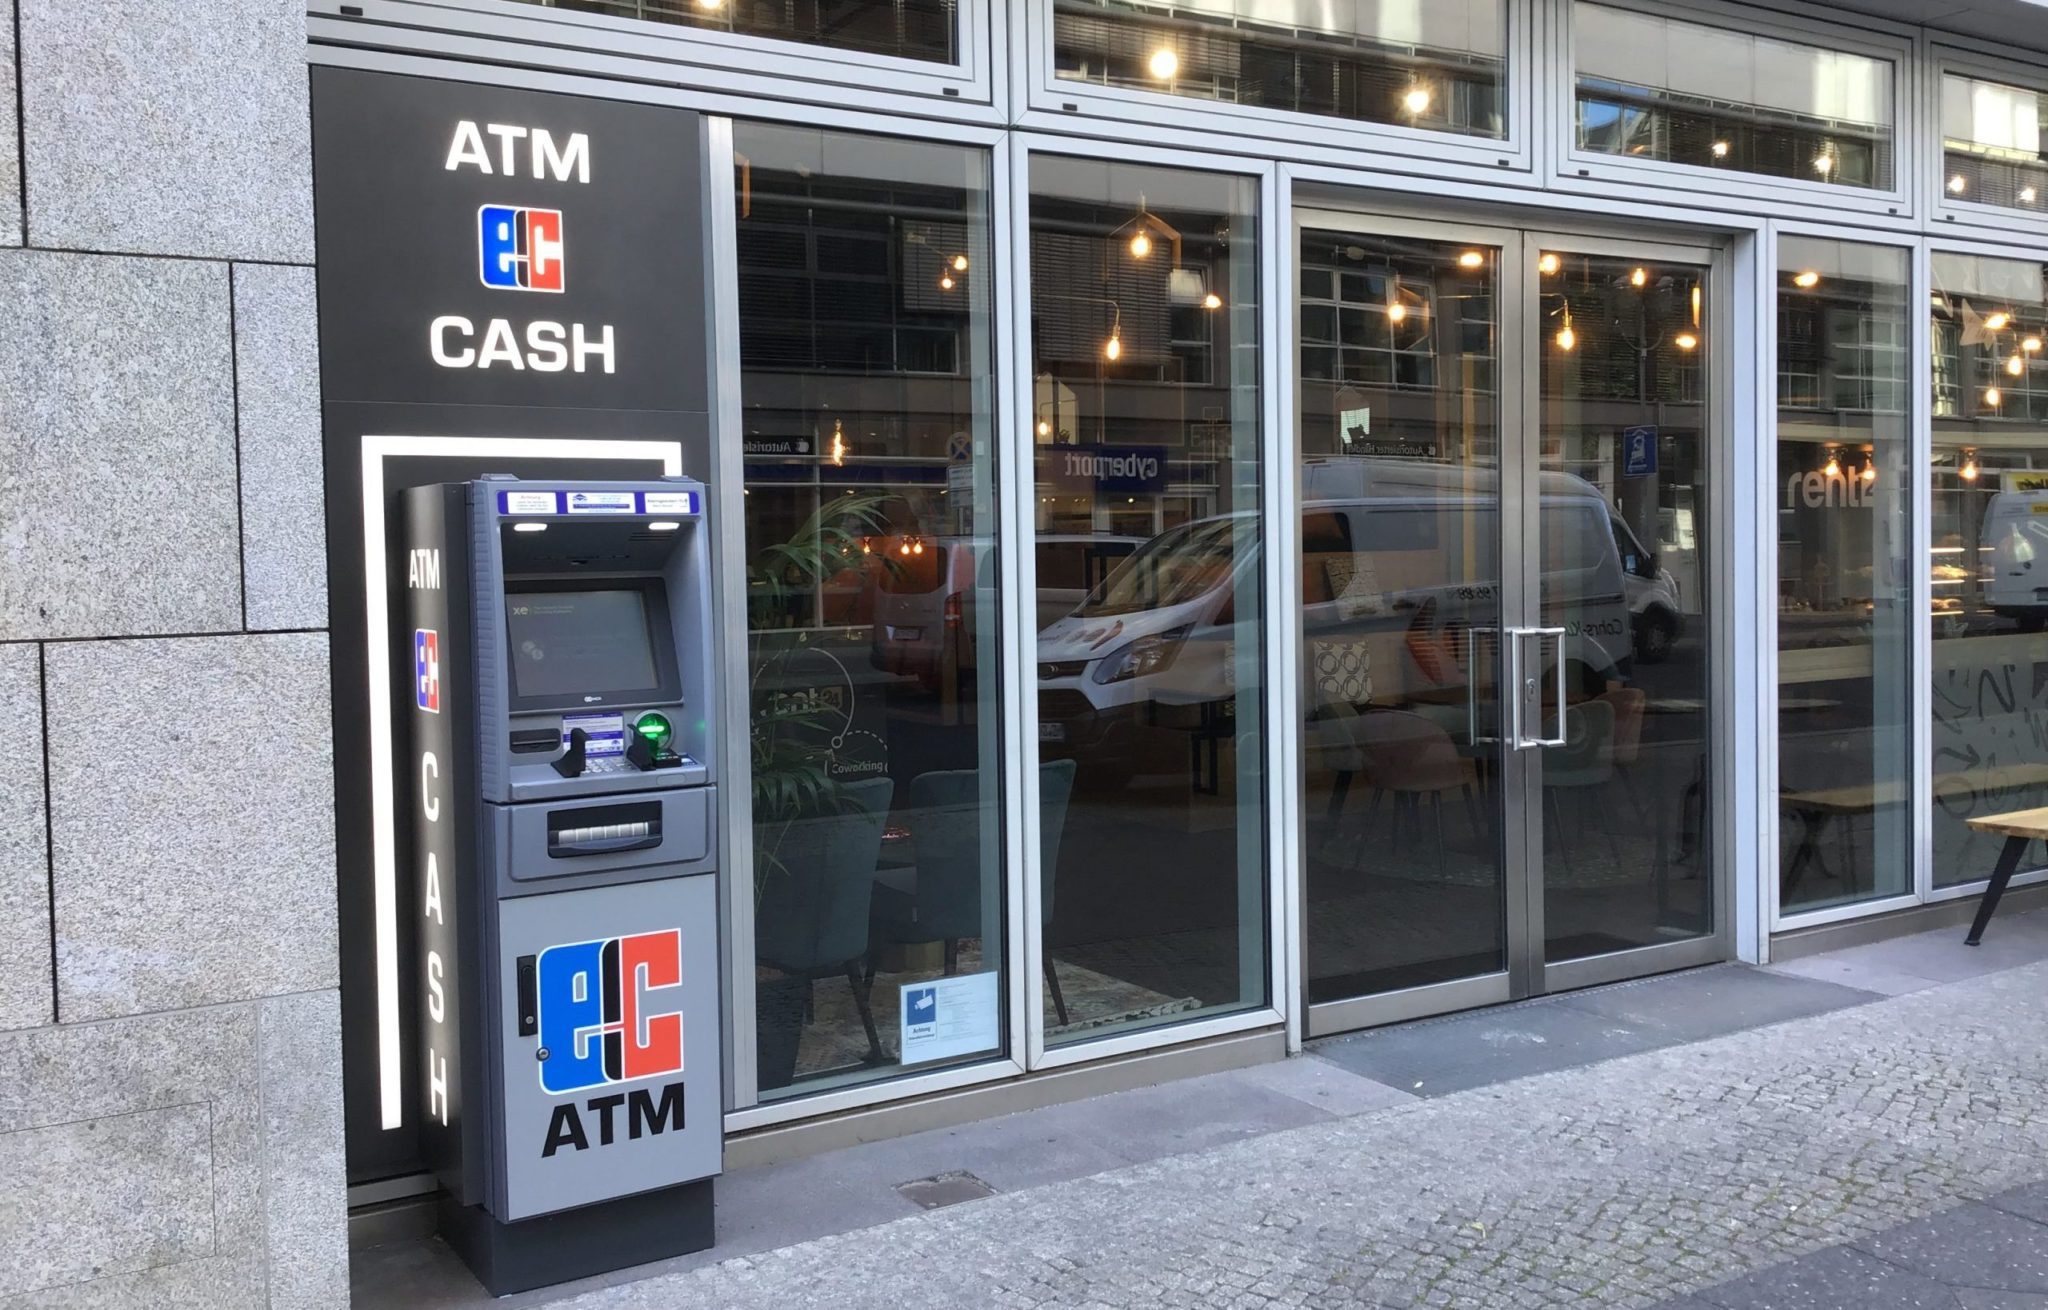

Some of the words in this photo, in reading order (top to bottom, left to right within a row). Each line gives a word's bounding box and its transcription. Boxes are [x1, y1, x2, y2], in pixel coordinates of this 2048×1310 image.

[445, 119, 592, 184] ATM
[429, 315, 616, 374] CASH
[409, 548, 440, 590] ATM
[512, 606, 529, 616] xe
[542, 1083, 685, 1158] ATM
